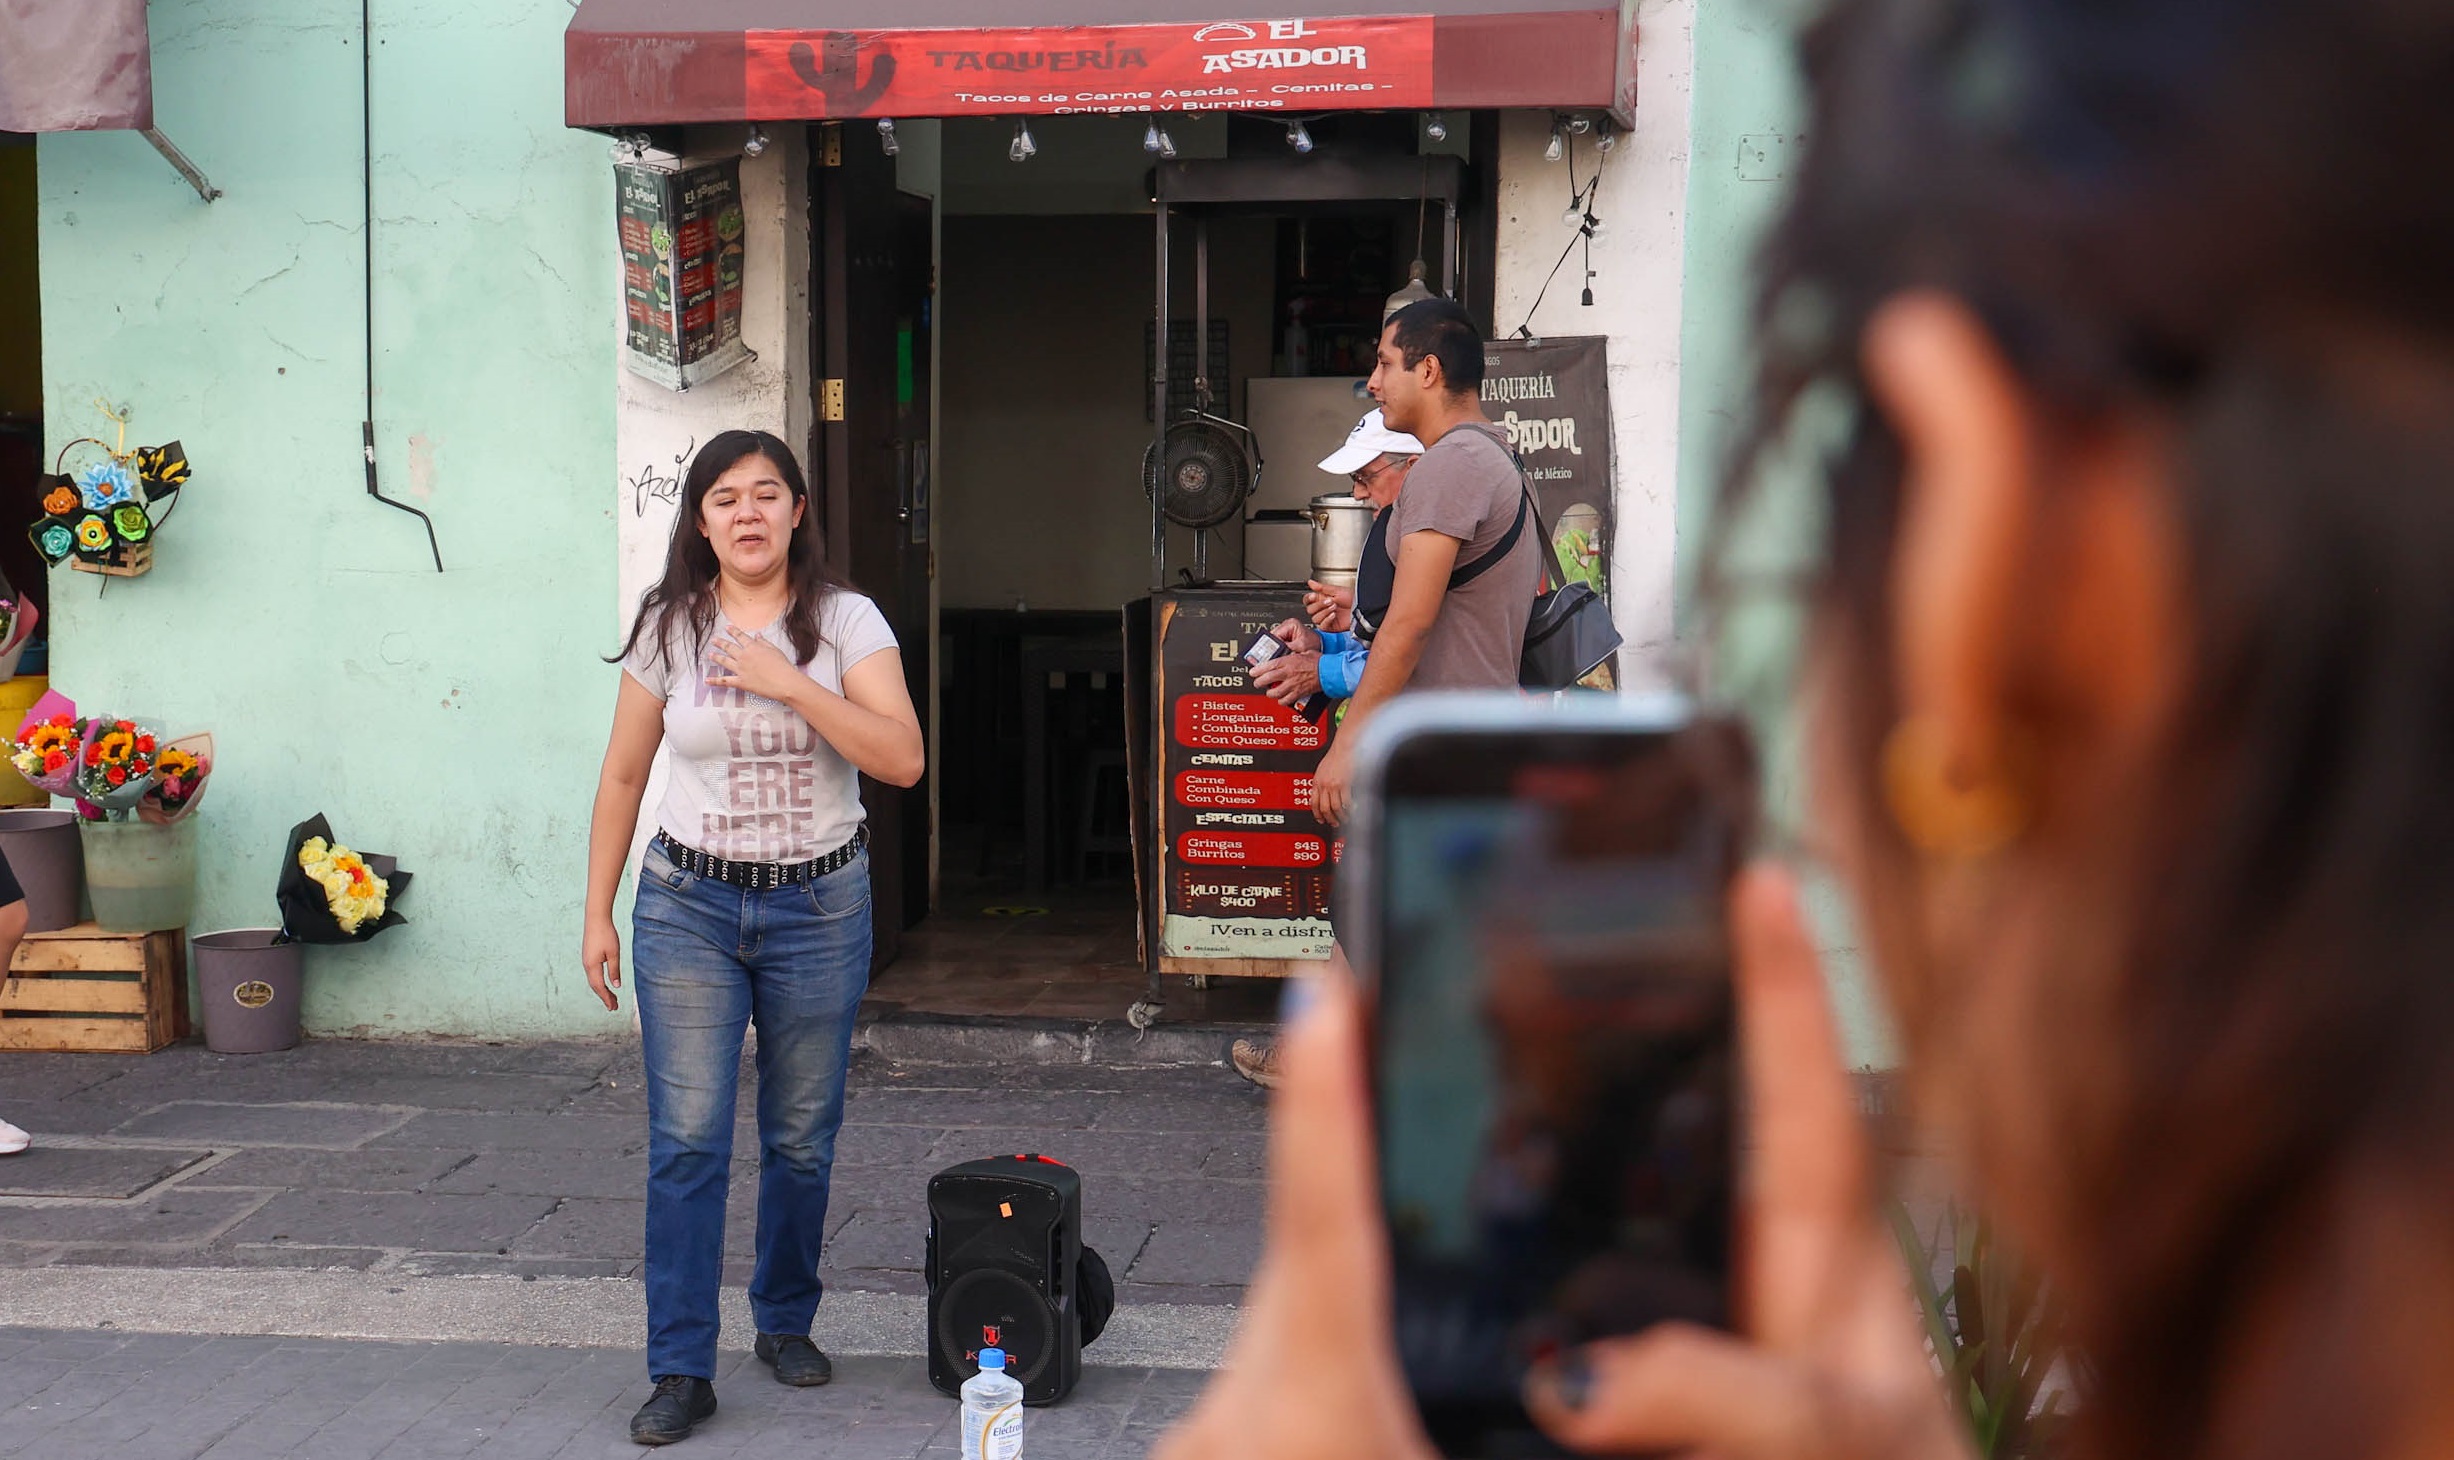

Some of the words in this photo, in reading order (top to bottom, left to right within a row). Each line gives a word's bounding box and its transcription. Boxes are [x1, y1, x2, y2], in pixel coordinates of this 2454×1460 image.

[1268, 18, 1317, 40] EL
[925, 40, 1148, 73] TAQUERÍA
[1202, 46, 1367, 74] ASADOR
[955, 93, 1031, 103] Tacos
[1038, 93, 1068, 103] de
[1075, 90, 1152, 101] Carne
[1160, 86, 1239, 98] Asada
[1271, 82, 1375, 94] Cemitas
[1054, 104, 1151, 114] Gringas
[1182, 99, 1284, 110] Burritos
[1480, 370, 1556, 404] TAQUERÍA
[1493, 411, 1582, 455] SADOR
[1534, 467, 1543, 480] de
[1545, 466, 1573, 480] México
[1193, 675, 1243, 687] TACOS
[1202, 701, 1245, 710] Bistec
[1202, 712, 1275, 723] Longaniza
[718, 711, 817, 758] YOU
[1201, 723, 1290, 734] Combinados
[1293, 726, 1319, 735] $20
[1201, 735, 1229, 744] Con
[1232, 735, 1277, 746] Queso
[1293, 737, 1318, 746] $25
[1191, 753, 1254, 765] CEMITAS
[1186, 775, 1226, 784] Carne
[1186, 785, 1262, 795] Combinada
[1186, 794, 1211, 803] Con
[1215, 795, 1256, 805] Queso
[1195, 812, 1285, 825] ESPECIALES
[700, 811, 815, 861] HERE
[1187, 838, 1243, 850] Gringas
[1294, 841, 1320, 851] $45
[1187, 848, 1246, 859] Burritos
[1293, 852, 1320, 861] $90
[1190, 884, 1219, 897] KILO
[1221, 885, 1239, 895] DE
[1241, 886, 1283, 898] CARNE
[1220, 896, 1256, 907] $400
